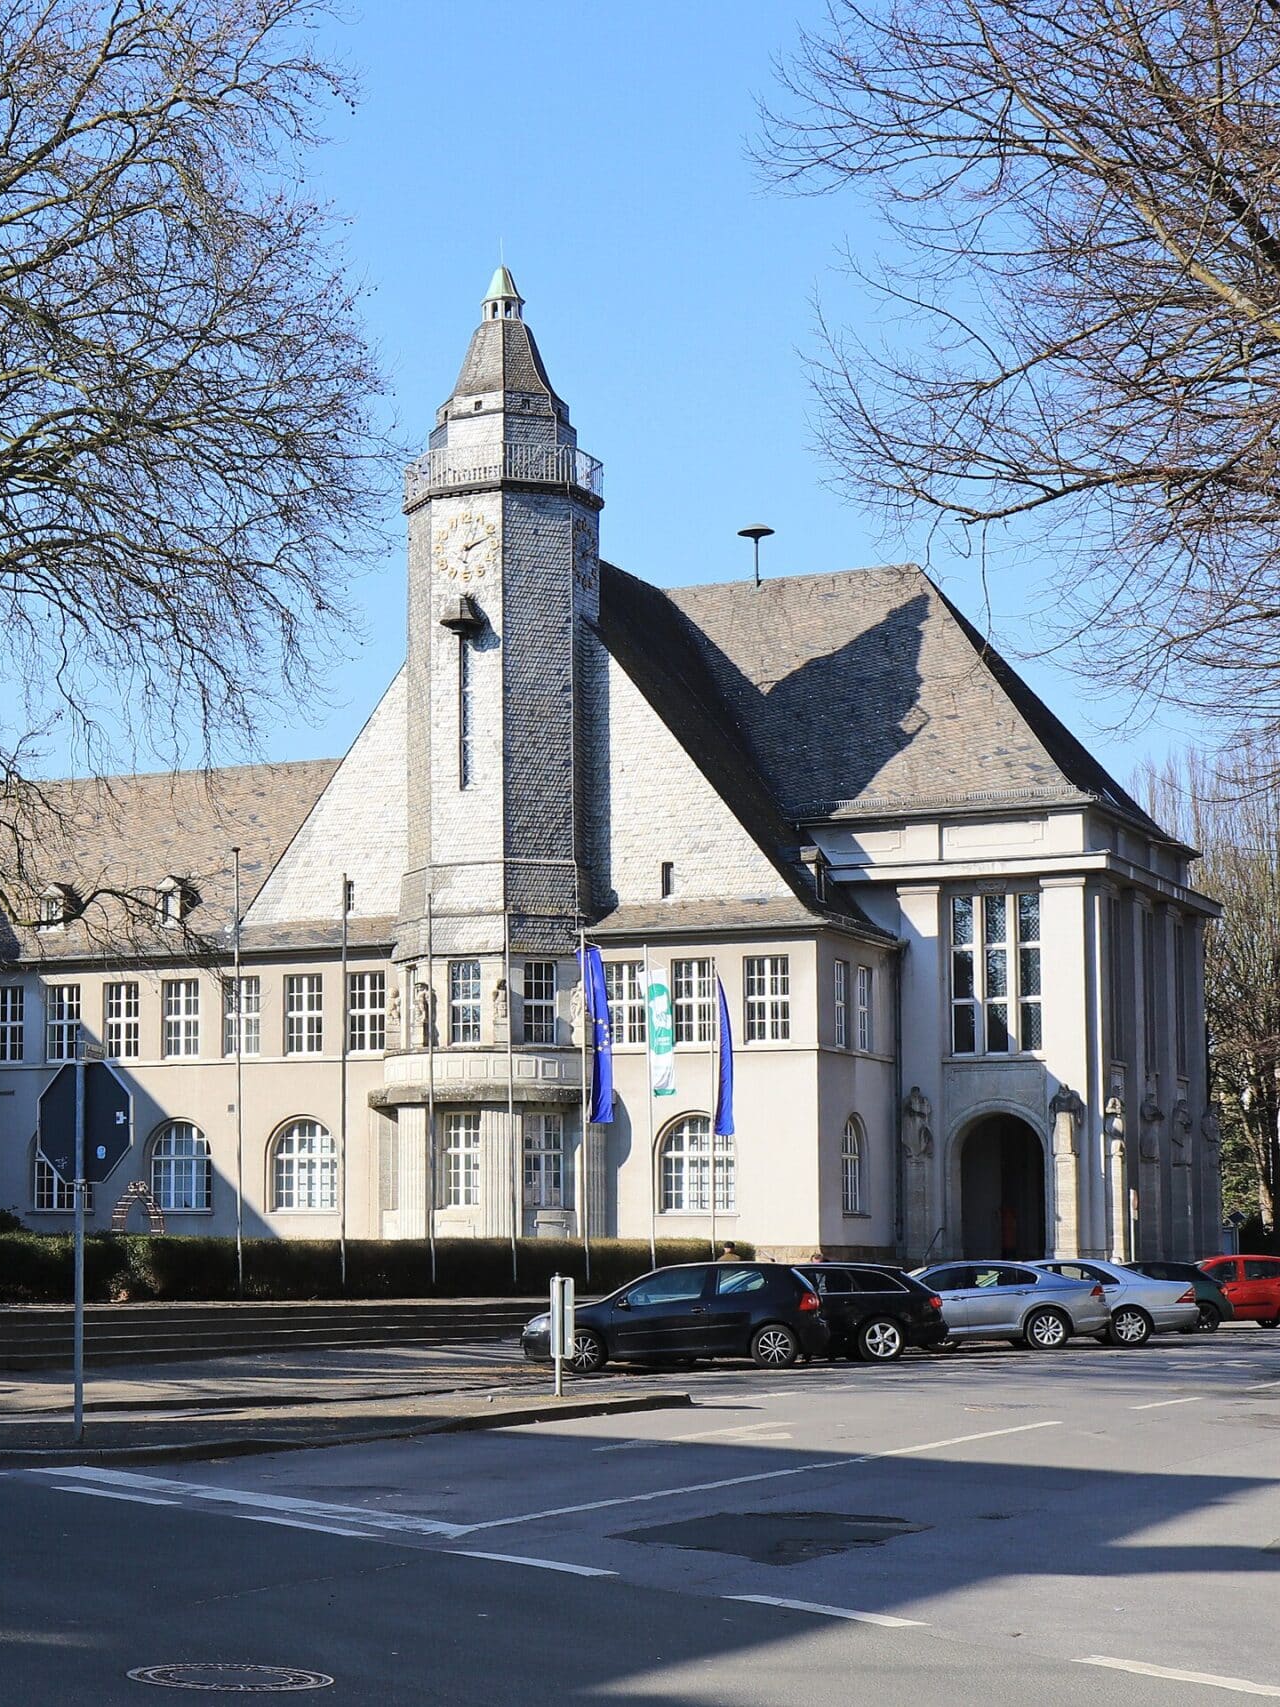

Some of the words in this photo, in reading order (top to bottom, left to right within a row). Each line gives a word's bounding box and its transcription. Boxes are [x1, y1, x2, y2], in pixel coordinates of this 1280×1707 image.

[460, 512, 472, 524] 12
[486, 523, 496, 534] 2
[490, 539, 500, 551] 3
[485, 552, 496, 564] 4
[437, 558, 448, 571] 8
[474, 564, 485, 577] 5
[460, 570, 472, 582] 6
